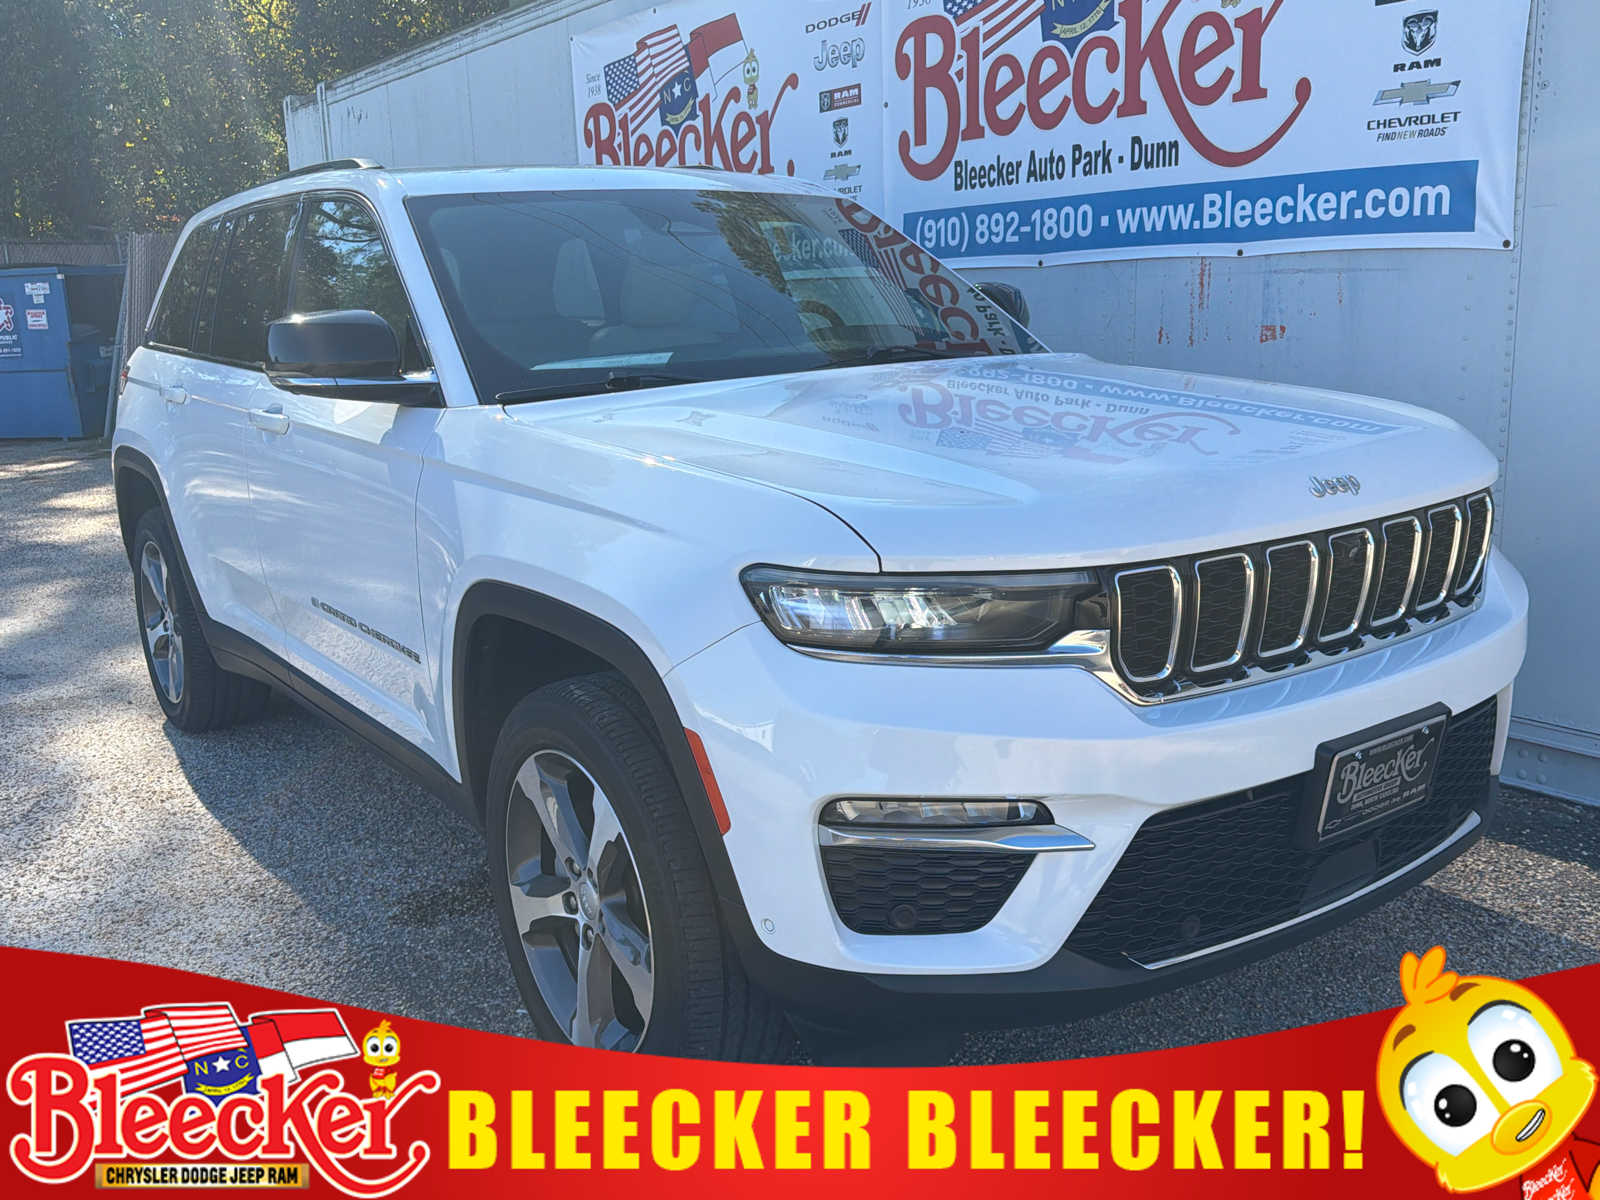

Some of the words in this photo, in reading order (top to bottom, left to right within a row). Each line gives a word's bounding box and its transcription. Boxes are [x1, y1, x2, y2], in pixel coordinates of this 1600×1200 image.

[805, 10, 862, 33] DODGE
[813, 37, 865, 71] Jeep
[1393, 57, 1442, 73] RAM
[833, 88, 859, 100] RAM
[895, 0, 1312, 181] Bleecker
[584, 73, 799, 177] Bleecker
[1367, 111, 1461, 131] CHEVROLET
[830, 149, 852, 159] RAM
[954, 154, 1022, 192] Bleecker
[1026, 149, 1065, 182] Auto
[1071, 140, 1113, 178] Park
[1130, 136, 1179, 171] Dunn
[915, 212, 969, 253] (910)
[975, 204, 1093, 245] 892-1800
[1116, 183, 1451, 234] www.Bleecker.com
[1309, 474, 1361, 498] Jeep
[1337, 737, 1435, 804] Bleecker
